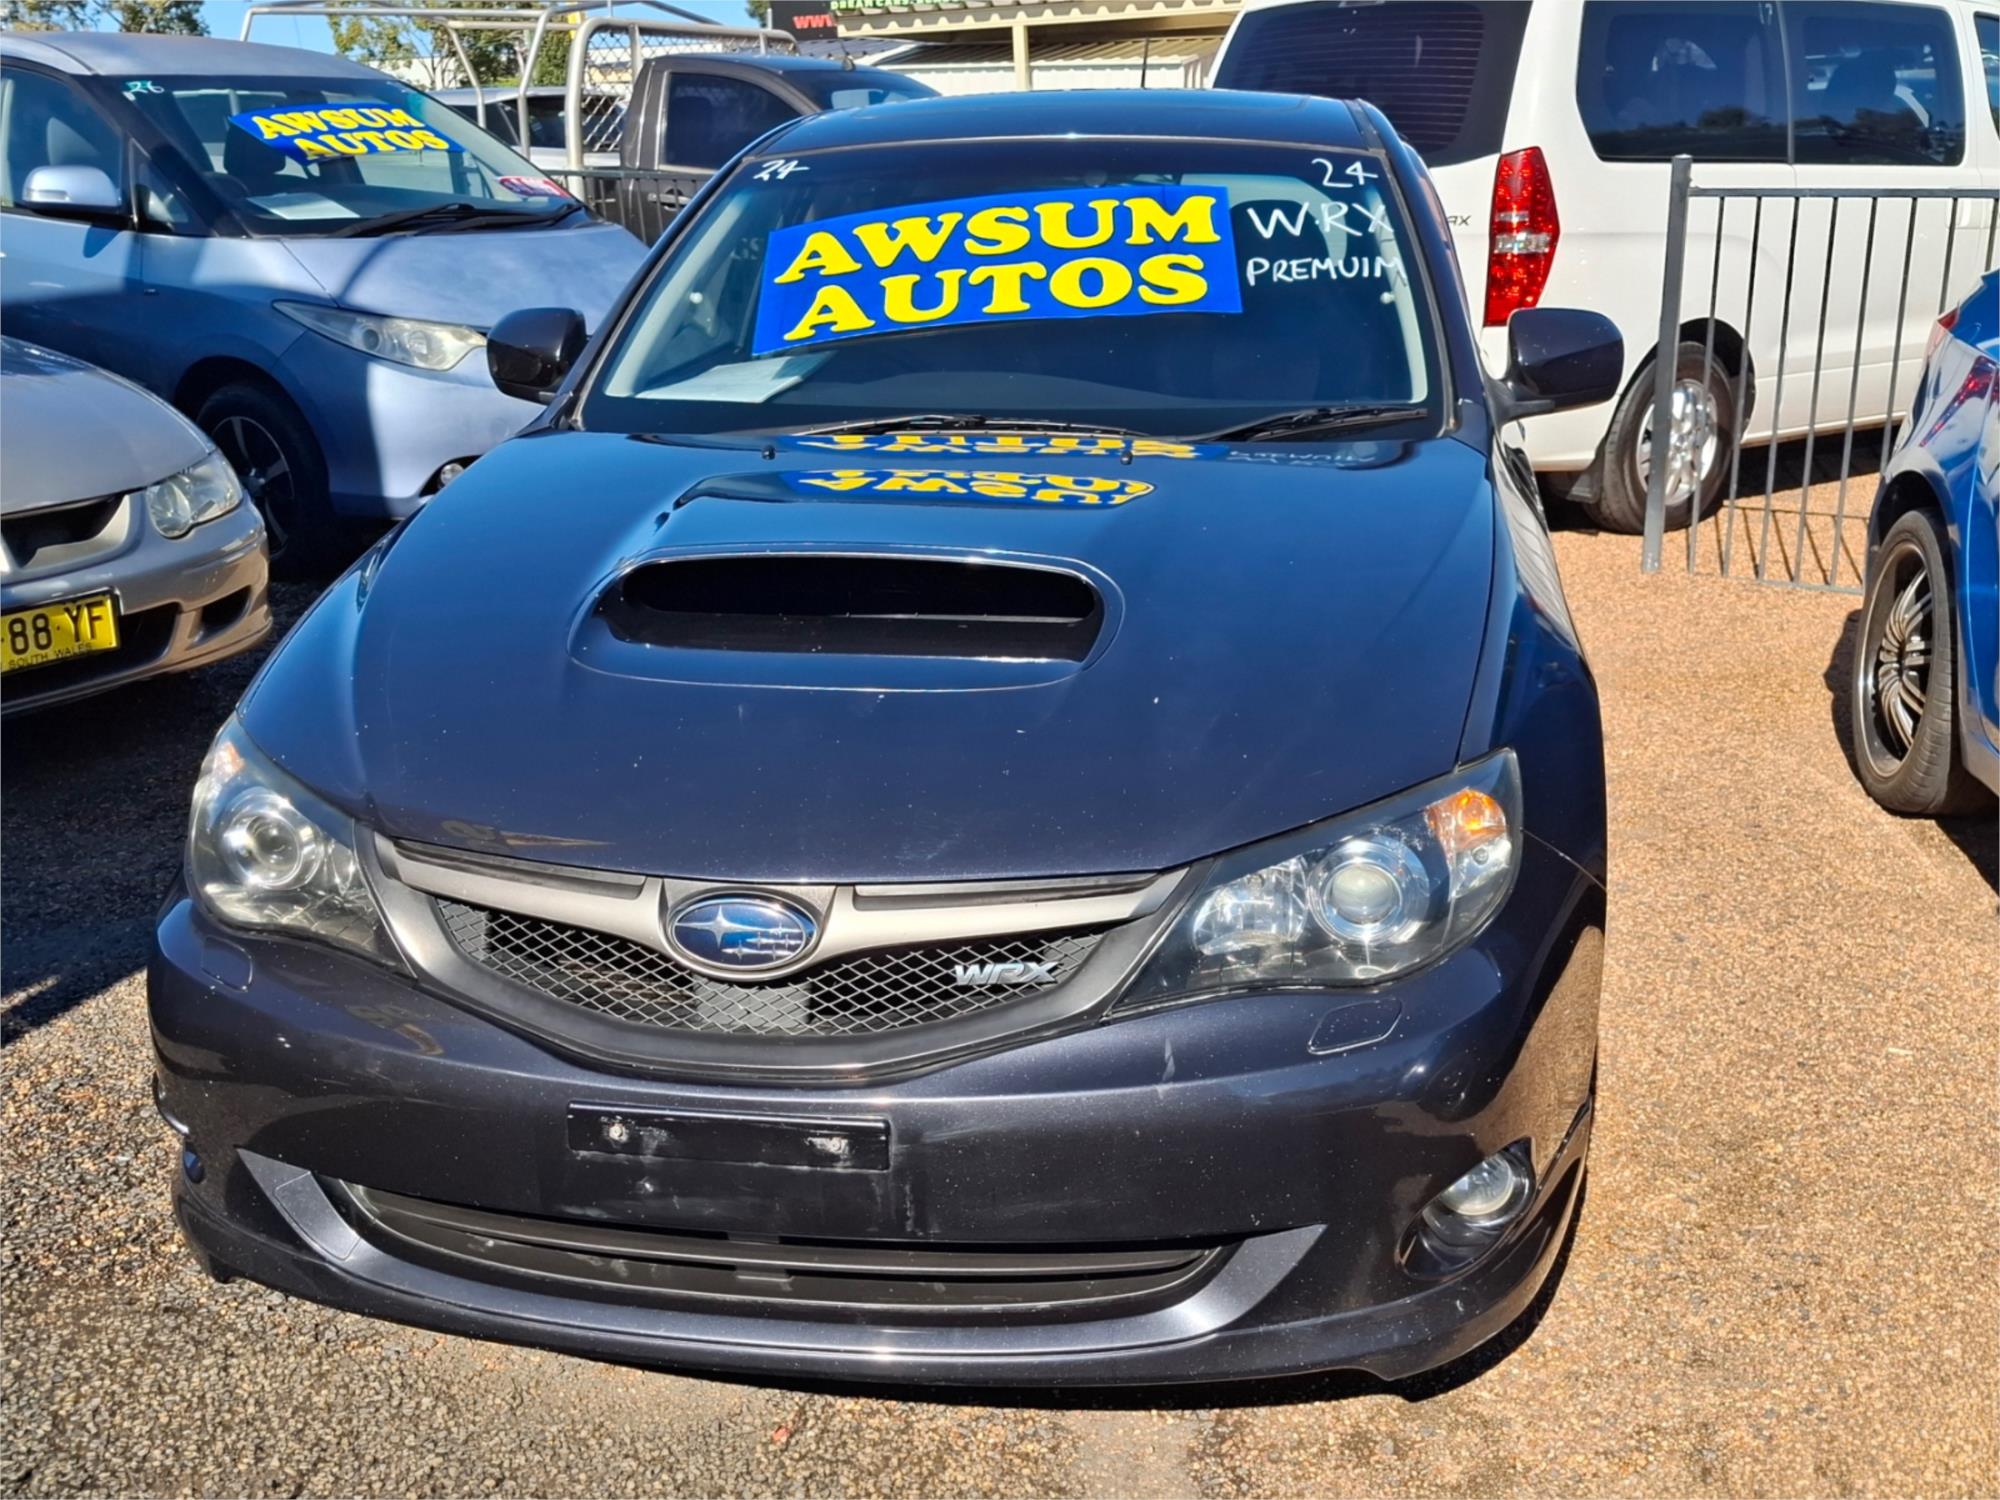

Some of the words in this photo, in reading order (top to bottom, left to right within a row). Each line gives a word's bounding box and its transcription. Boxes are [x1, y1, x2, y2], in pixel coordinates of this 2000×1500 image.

[252, 108, 425, 140] AWSUM
[294, 130, 449, 160] AUTOS
[755, 160, 809, 180] 24
[1311, 158, 1378, 188] 24
[774, 195, 1221, 285] AWSUM
[1246, 256, 1408, 287] PREMUIM
[784, 253, 1209, 341] AUTOS
[953, 961, 1062, 986] WRX
